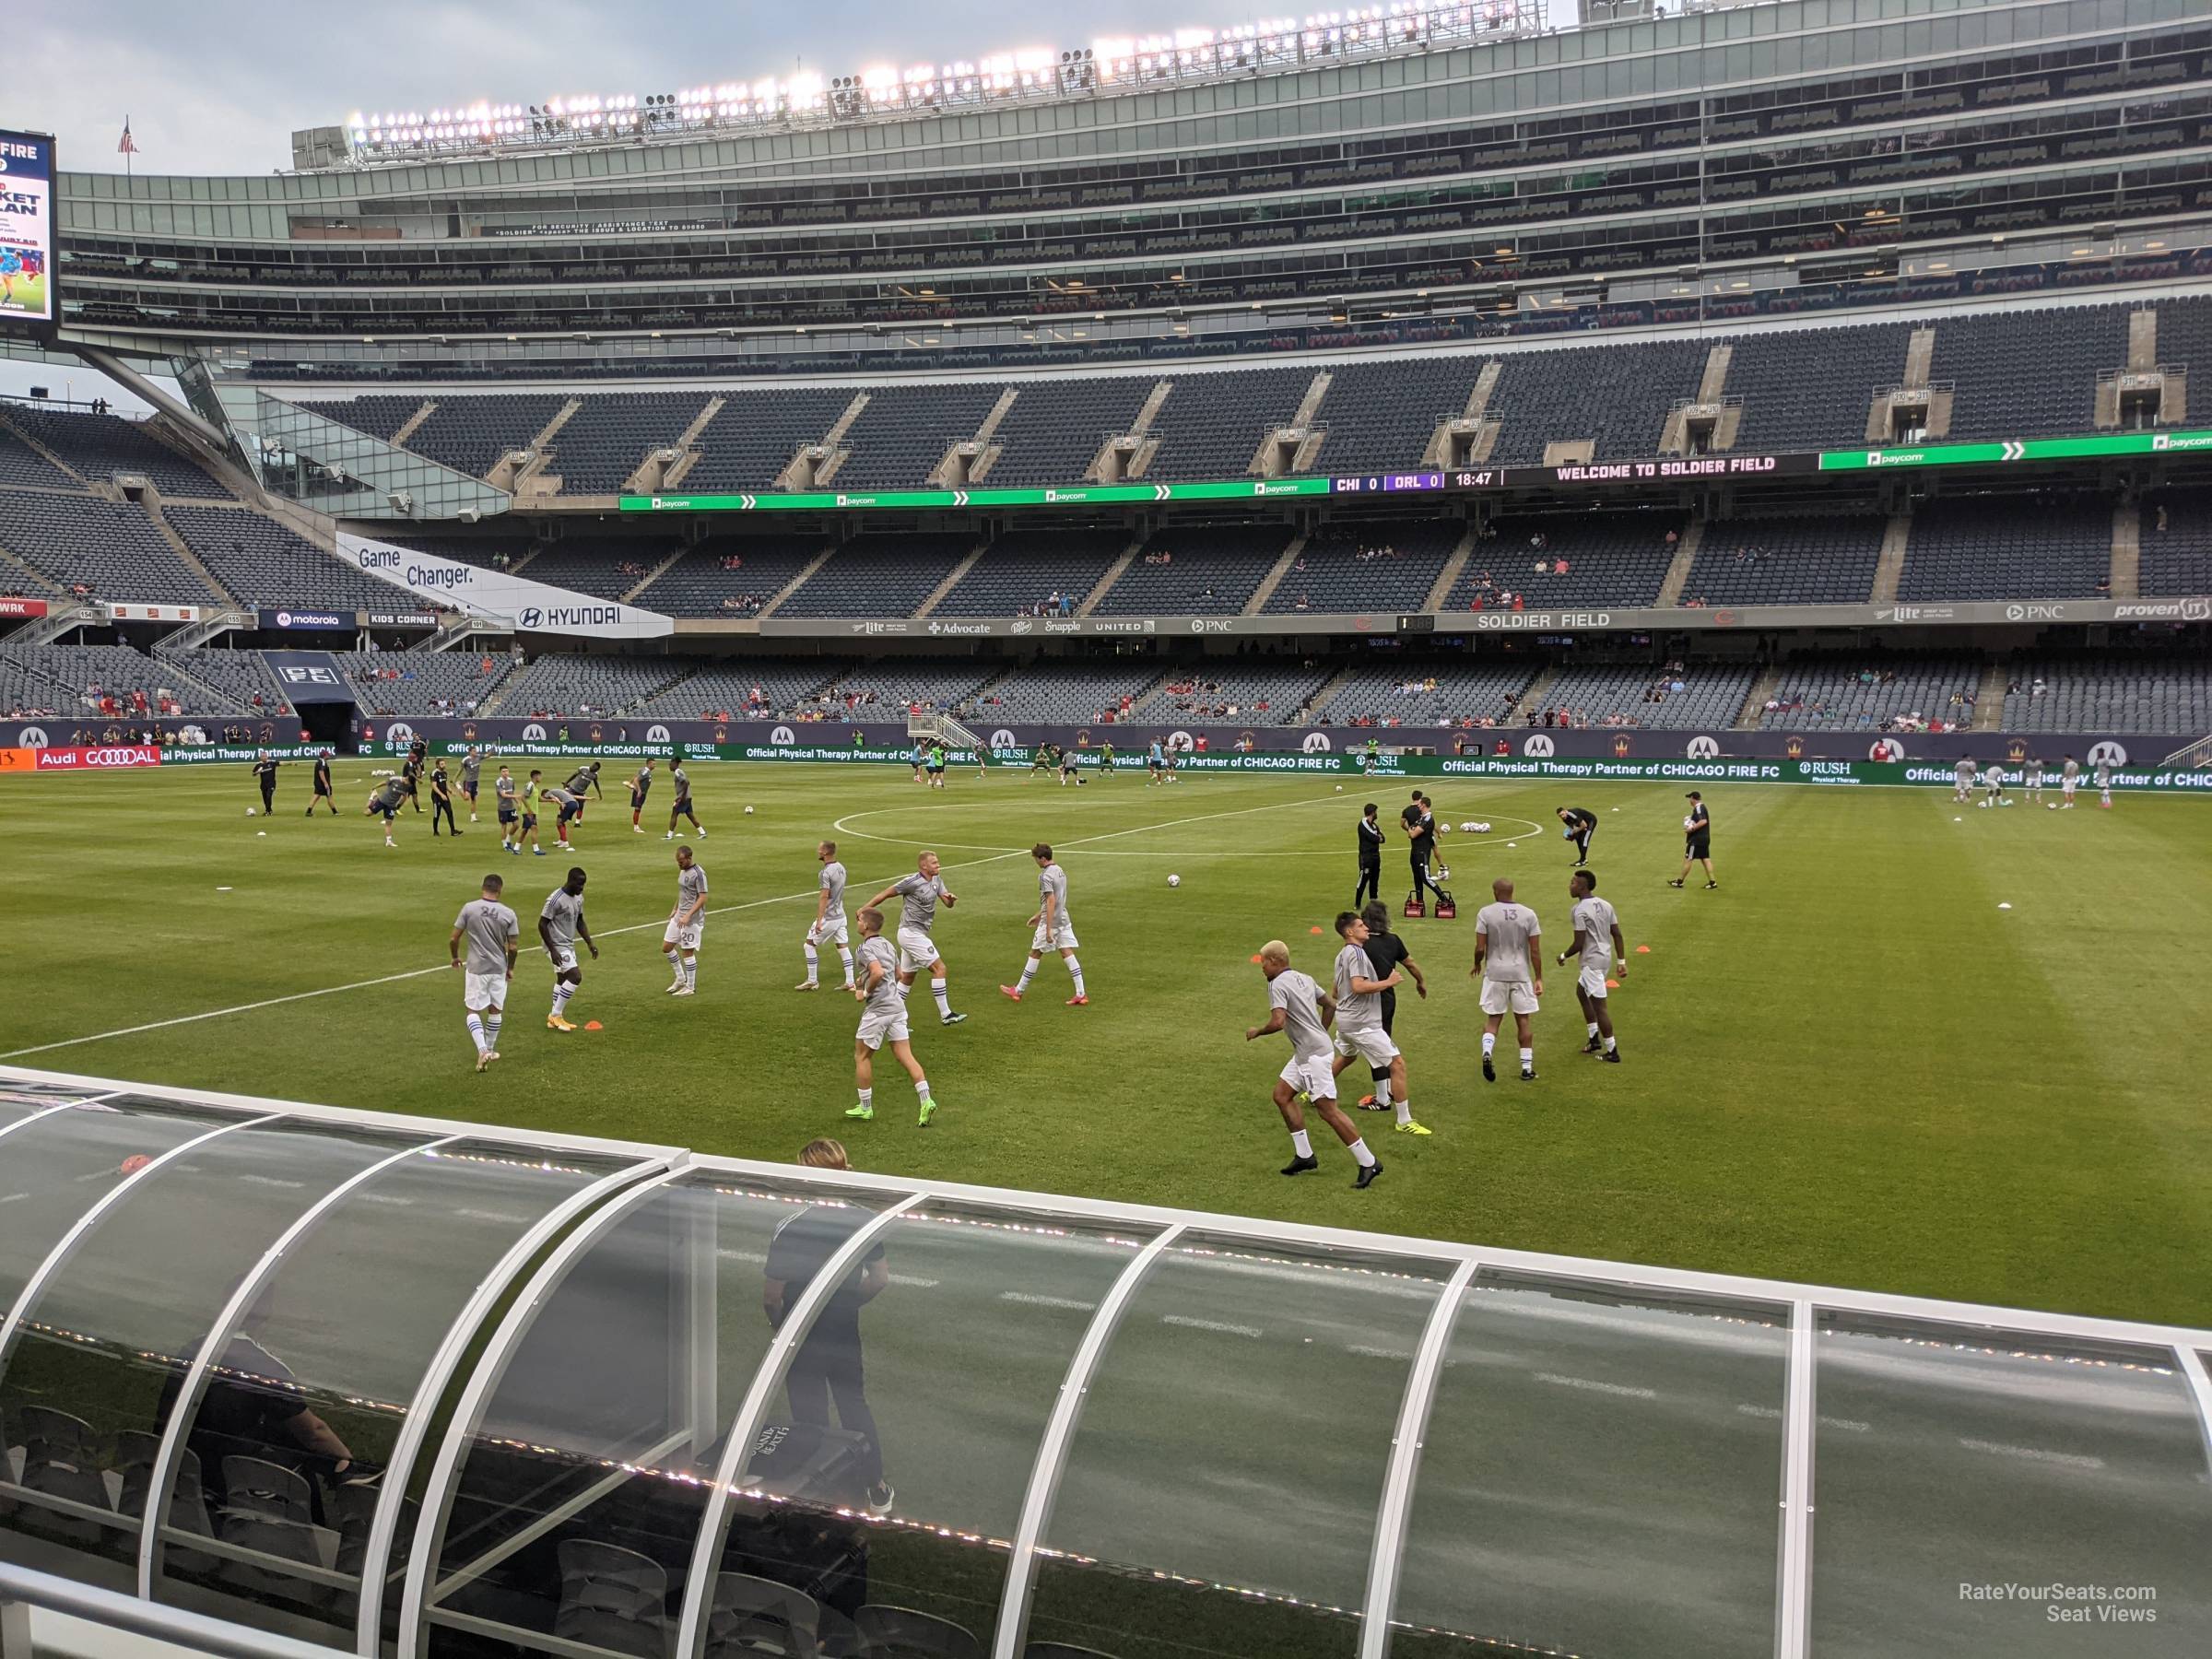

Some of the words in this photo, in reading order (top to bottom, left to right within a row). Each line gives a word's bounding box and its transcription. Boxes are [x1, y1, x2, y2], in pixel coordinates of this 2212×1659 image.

[1, 142, 38, 159] FIRE
[2170, 436, 2212, 449] paycom
[1882, 453, 1924, 465] paycom
[1558, 464, 1630, 481] WELCOME
[1636, 463, 1655, 477] TO
[1661, 460, 1725, 476] SOLDIER
[1731, 457, 1775, 472] FIELD
[1337, 478, 1359, 490] CHI
[1370, 477, 1377, 490] 0
[1430, 476, 1438, 487] 0
[1456, 472, 1492, 486] 18:47
[1266, 485, 1298, 494] paycom
[847, 498, 877, 506] paycom
[1056, 492, 1087, 501] paycom
[359, 548, 400, 568] Game
[407, 565, 473, 589] Changer.
[81, 610, 92, 618] 154
[548, 606, 620, 625] HYUNDAI
[1893, 606, 1920, 622] Lite
[2028, 606, 2065, 619] PNC
[2114, 604, 2179, 618] proven
[293, 616, 339, 625] motorola
[371, 615, 394, 623] KIDS
[397, 616, 436, 625] CORNER
[1206, 620, 1232, 631] PNC
[1478, 616, 1550, 629] SOLDIER
[1561, 614, 1609, 627] FIELD
[866, 621, 885, 634] Lite
[943, 621, 990, 634] Advocate
[1045, 621, 1081, 634] Snapple
[359, 745, 372, 754] FC
[526, 744, 560, 756] Therapy
[562, 745, 591, 754] Partner
[594, 745, 602, 754] of
[603, 745, 641, 755] CHICAGO
[643, 746, 660, 755] FIRE
[662, 747, 674, 756] FC
[692, 744, 715, 753] RUSH
[747, 748, 777, 758] Official
[779, 748, 814, 759] Physical
[817, 749, 852, 760] Therapy
[853, 750, 887, 759] Partner
[888, 750, 898, 759] of
[947, 751, 966, 761] FIRE
[1002, 748, 1029, 759] RUSH
[41, 752, 76, 765] Audi
[175, 748, 216, 764] Physical
[218, 747, 255, 761] Therapy
[293, 747, 301, 757] of
[1103, 755, 1143, 767] hysical
[1190, 756, 1229, 767] Partner
[1231, 758, 1242, 767] of
[1244, 758, 1296, 769] CHICAGO
[1298, 759, 1322, 769] FIRE
[1325, 759, 1340, 769] FC
[1370, 756, 1397, 767] USH
[1442, 761, 1486, 772] Official
[1488, 761, 1538, 774] Physical
[1541, 763, 1592, 776] Therapy
[1595, 763, 1642, 774] Partner
[1646, 763, 1659, 774] of
[1663, 764, 1725, 776] CHICAGO
[1728, 765, 1758, 777] FIRE
[1761, 765, 1779, 778] FC
[1812, 762, 1851, 774] RUSH
[1906, 769, 1958, 782] Official
[2037, 771, 2088, 786] herpy
[2154, 773, 2171, 785] of
[1502, 909, 1518, 920] 13
[681, 933, 695, 942] 20
